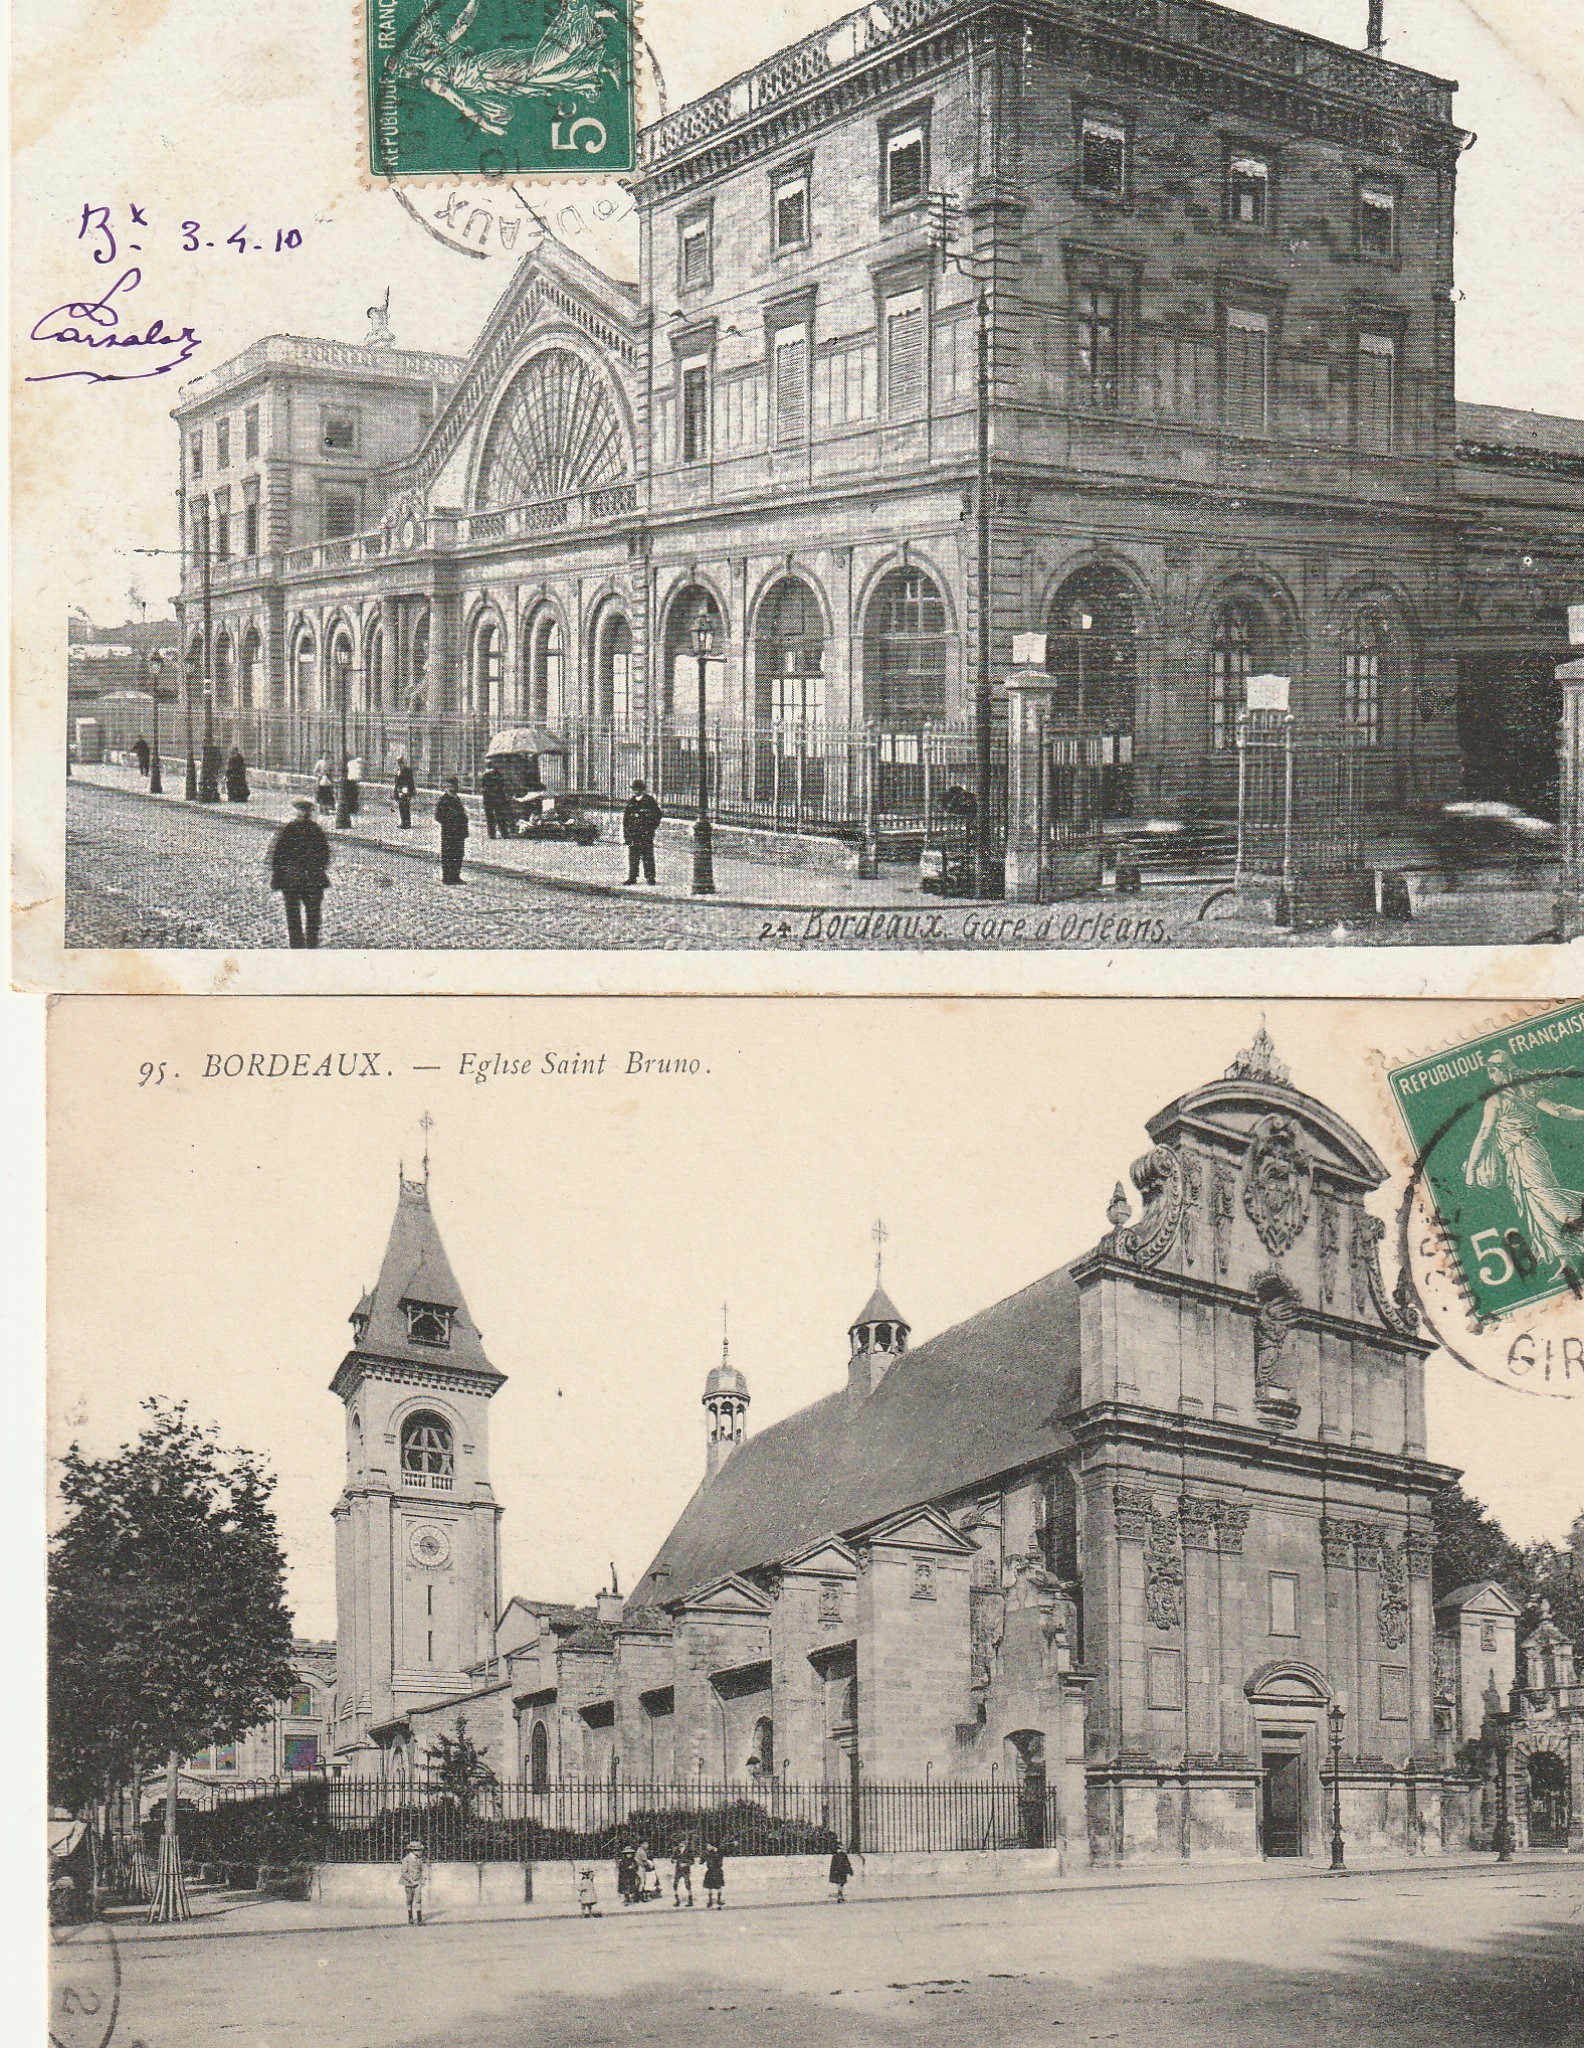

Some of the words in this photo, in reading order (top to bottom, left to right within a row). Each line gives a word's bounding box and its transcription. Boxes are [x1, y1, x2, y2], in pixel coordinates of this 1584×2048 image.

[962, 912, 1027, 940] Gare
[458, 1051, 532, 1084] Eglise
[540, 1051, 606, 1076] Saint
[1398, 1050, 1485, 1096] REPUBLIQUE
